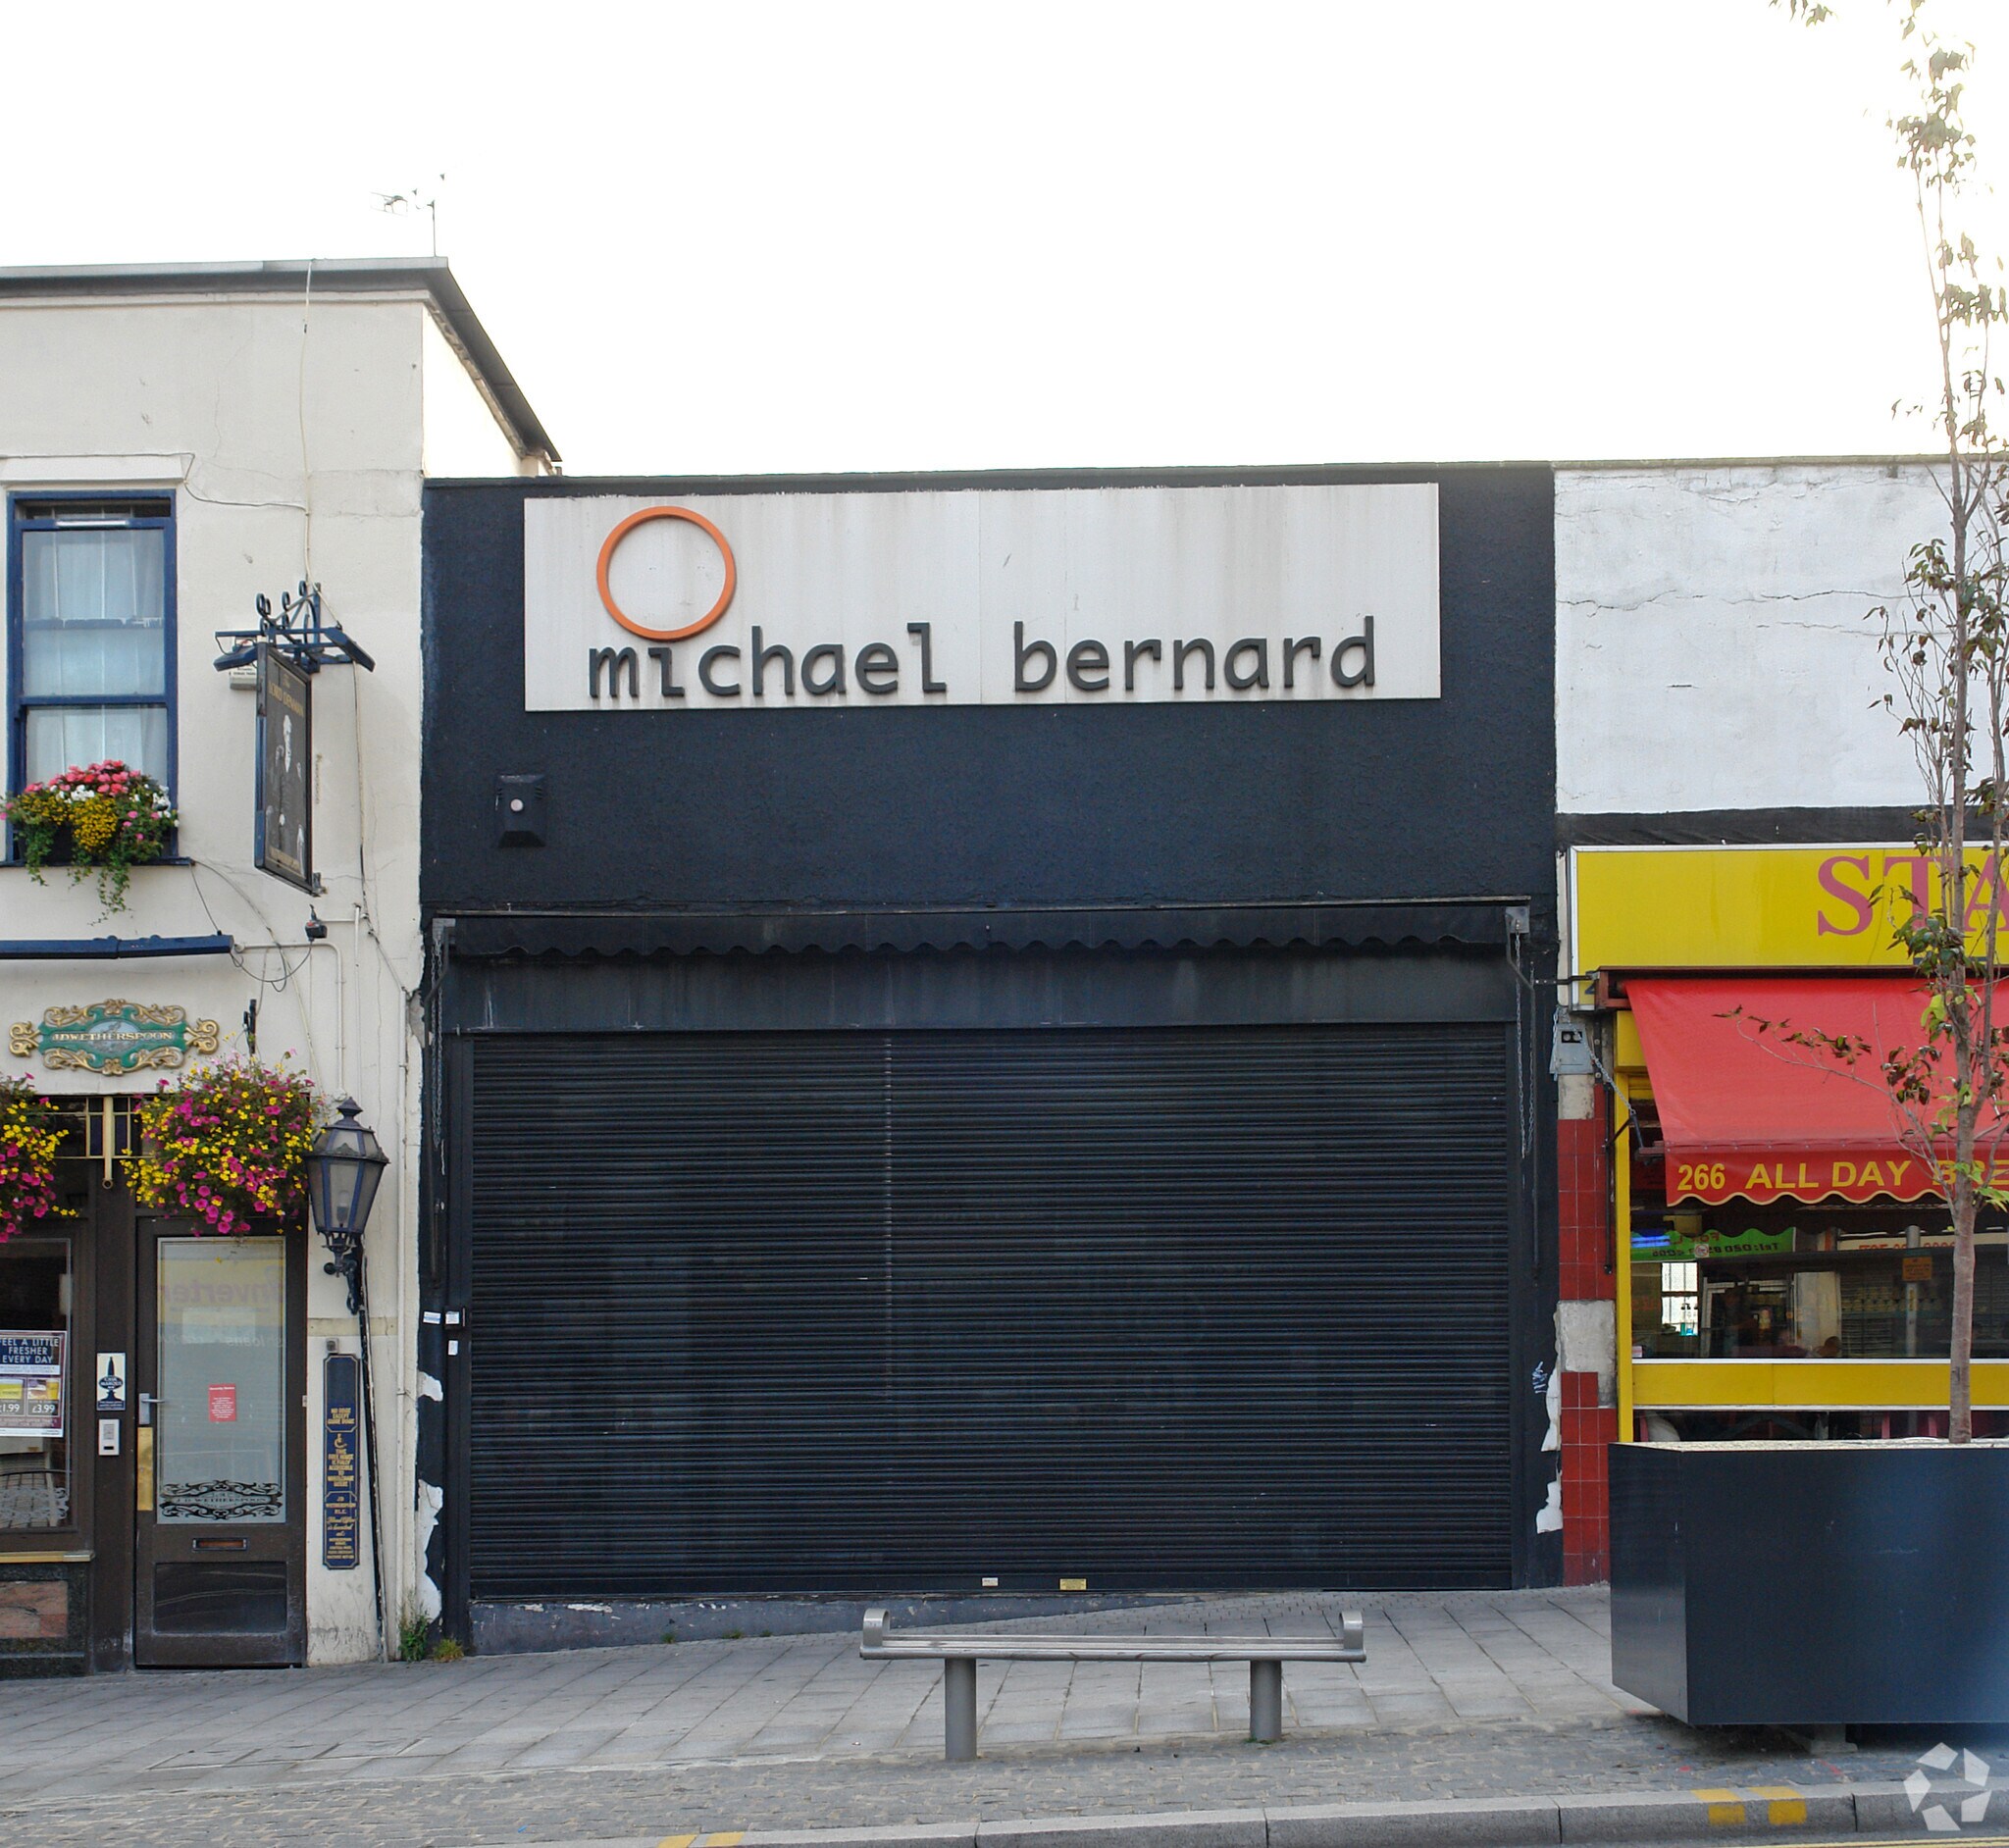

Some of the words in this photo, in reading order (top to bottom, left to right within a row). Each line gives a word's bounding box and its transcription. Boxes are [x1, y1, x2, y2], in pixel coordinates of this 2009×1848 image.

[589, 622, 947, 698] michael
[1013, 615, 1375, 692] bernard
[1676, 1163, 1726, 1191] 266
[1745, 1163, 1819, 1190] ALL
[1831, 1160, 1912, 1187] DAY
